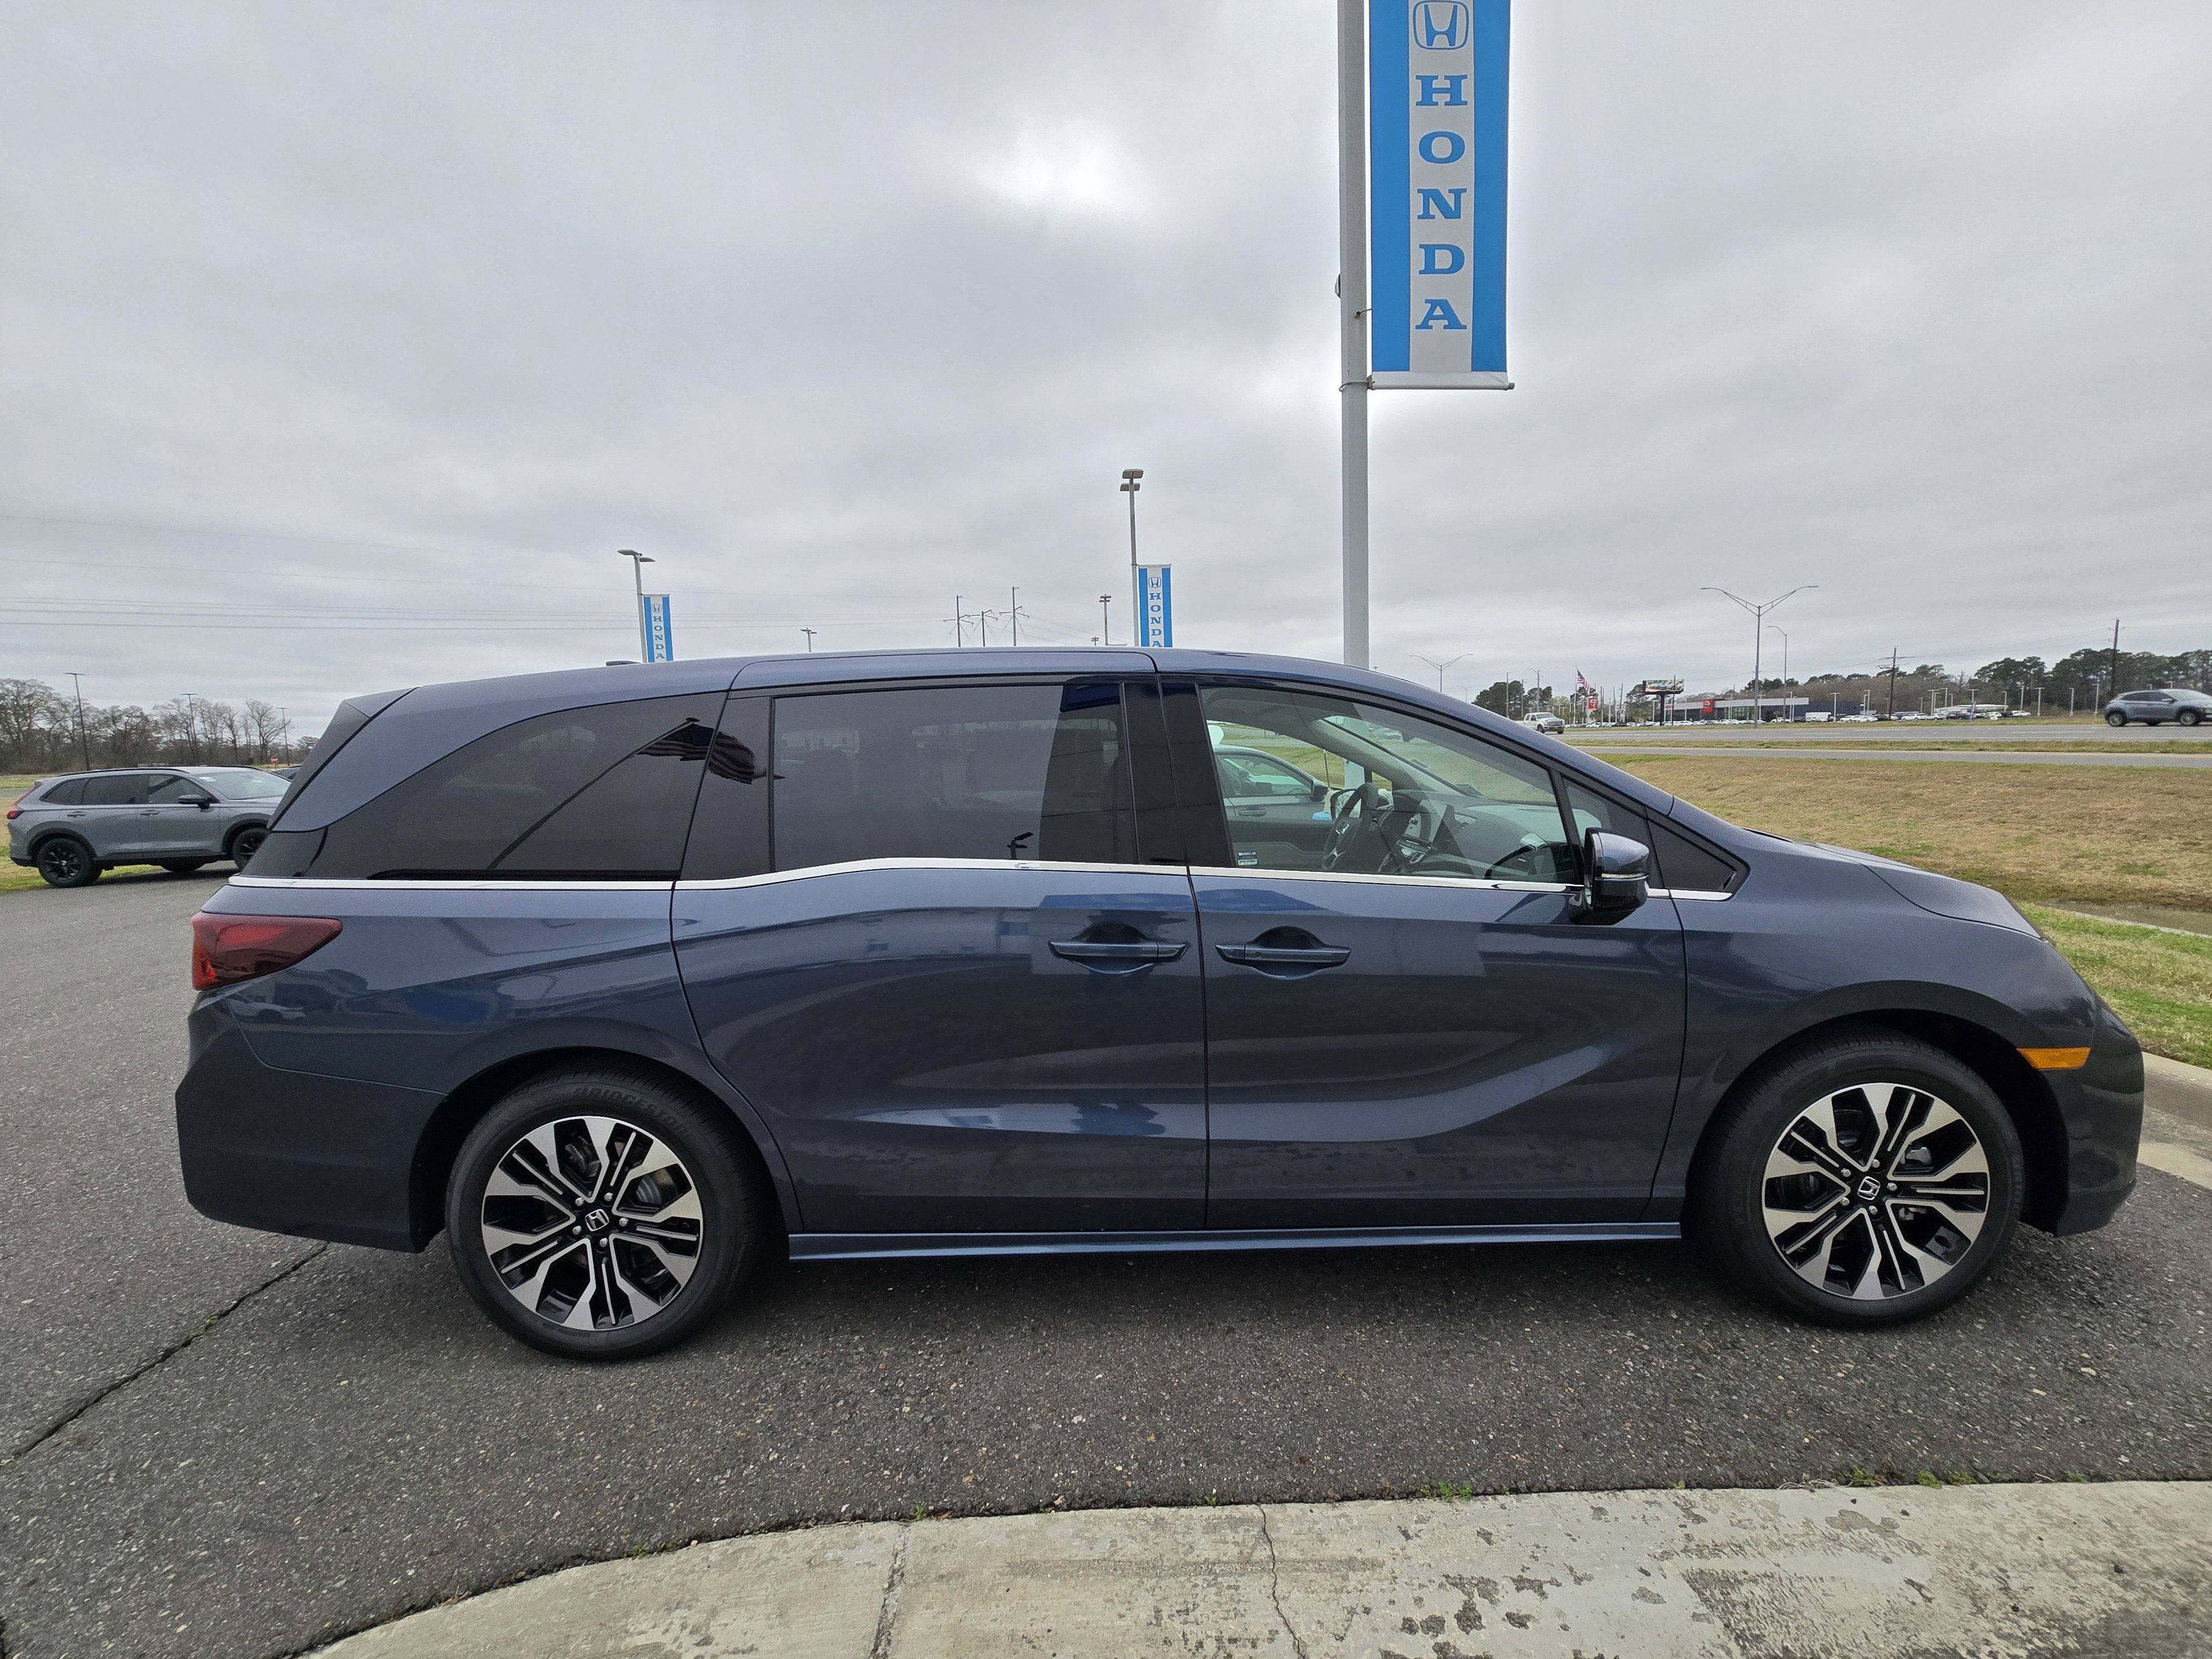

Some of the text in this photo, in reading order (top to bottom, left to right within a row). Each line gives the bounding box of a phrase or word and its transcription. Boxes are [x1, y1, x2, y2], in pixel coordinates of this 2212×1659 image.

[1415, 74, 1468, 330] HONDA
[653, 615, 665, 659] HONDA
[1149, 593, 1163, 648] HONDA
[573, 1086, 692, 1138] BRIDGESTON
